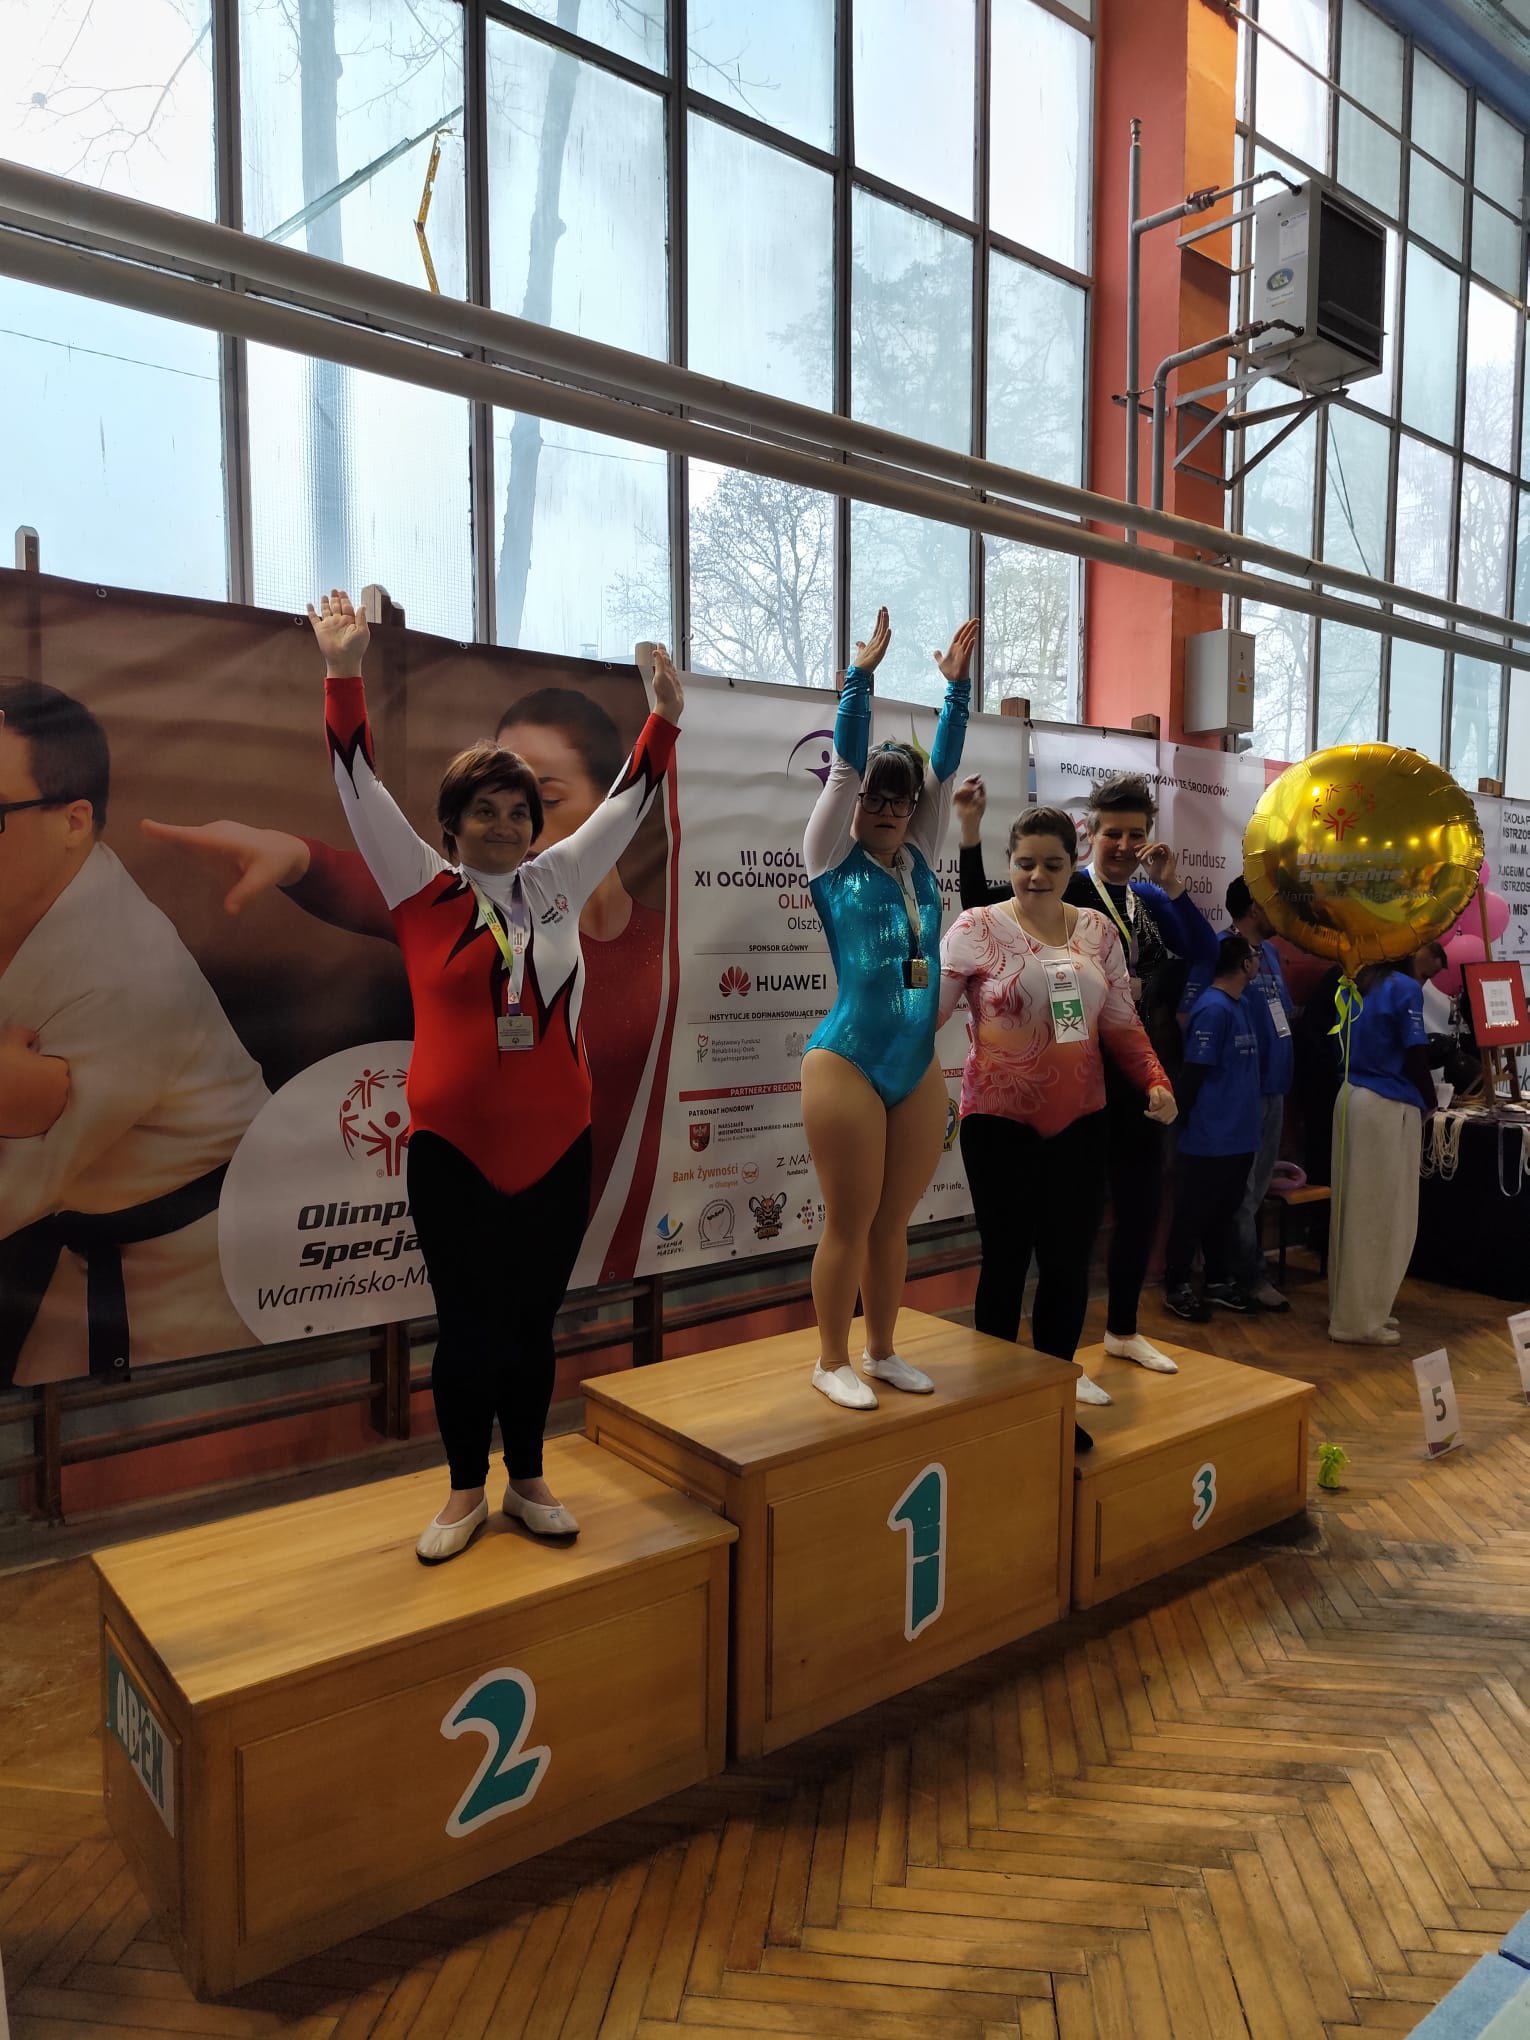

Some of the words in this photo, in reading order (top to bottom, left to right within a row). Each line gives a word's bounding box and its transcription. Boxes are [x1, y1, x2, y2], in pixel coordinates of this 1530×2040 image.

[1060, 763, 1097, 778] PROJEKT
[740, 850, 757, 866] III
[762, 848, 805, 868] OGÓL
[1182, 849, 1227, 870] Fundusz
[694, 870, 712, 887] XI
[716, 868, 810, 889] OGÓLNOPO
[1184, 876, 1213, 895] Osób
[778, 894, 816, 910] OLIM
[787, 917, 824, 933] Olszty
[748, 944, 780, 952] SPONSOR
[781, 943, 809, 952] GŁÓWNY
[756, 974, 827, 992] HUAWEI
[709, 1012, 751, 1021] INSTYTUCJE
[1062, 1001, 1074, 1018] 5
[730, 1085, 772, 1097] PARTNERZY
[772, 1083, 802, 1093] REGION
[689, 1108, 720, 1117] PATRONAT
[720, 1104, 755, 1114] HONOROWY
[776, 1157, 785, 1168] Z
[672, 1171, 695, 1183] Bank
[697, 1162, 739, 1182] Żywności
[297, 1200, 412, 1230] Olimp
[300, 1230, 422, 1270] Specja
[257, 1264, 433, 1310] Warmińsko-M
[1431, 1385, 1447, 1422] 5
[1191, 1462, 1218, 1530] 3
[887, 1461, 948, 1642] 1
[439, 1666, 552, 1838] 2
